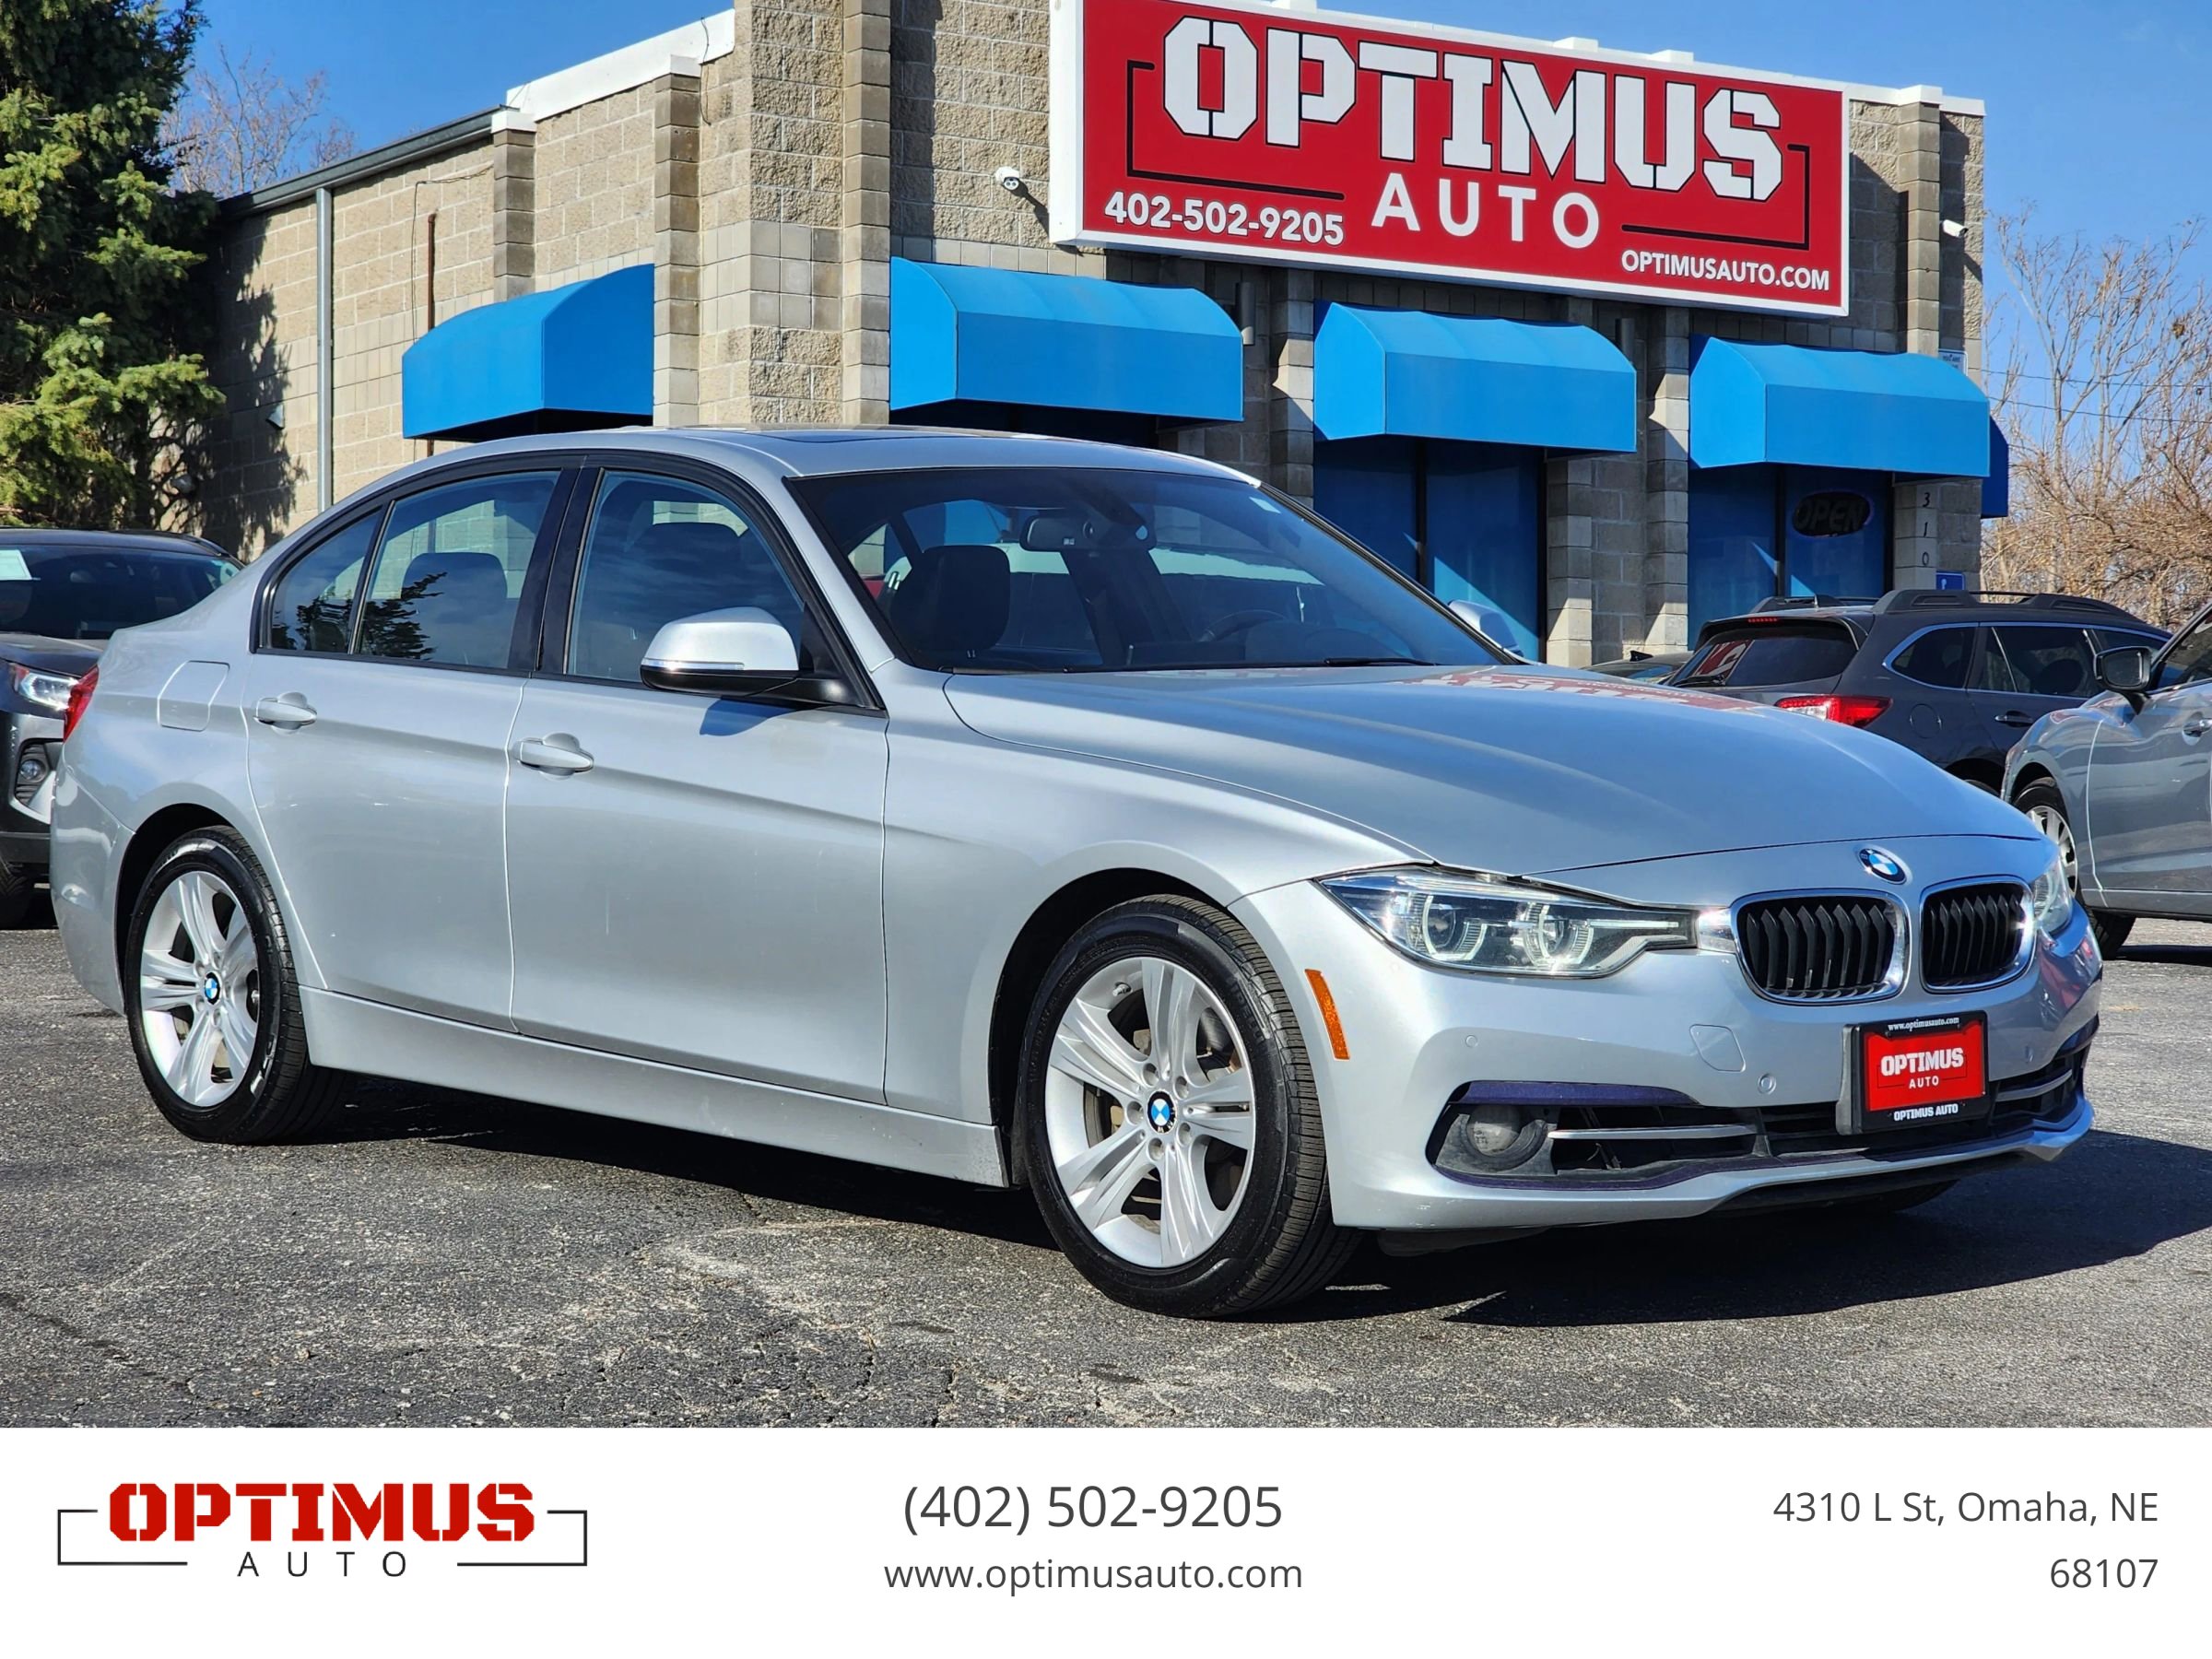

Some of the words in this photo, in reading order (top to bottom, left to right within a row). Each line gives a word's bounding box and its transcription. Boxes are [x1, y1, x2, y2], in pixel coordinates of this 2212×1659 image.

[1162, 15, 1783, 203] OPTIMUS
[1104, 191, 1345, 246] 402-502-9205
[1371, 172, 1600, 249] AUTO
[1621, 249, 1830, 291] OPTIMUSAUTO.COM
[1793, 499, 1865, 533] OPEN
[1888, 1017, 1959, 1032] www.optimusauto.com
[1880, 1047, 1964, 1077] OPTIMUS
[1909, 1075, 1939, 1089] AUTO
[1893, 1106, 1935, 1122] OPTIMUS
[1936, 1103, 1959, 1116] AUTO
